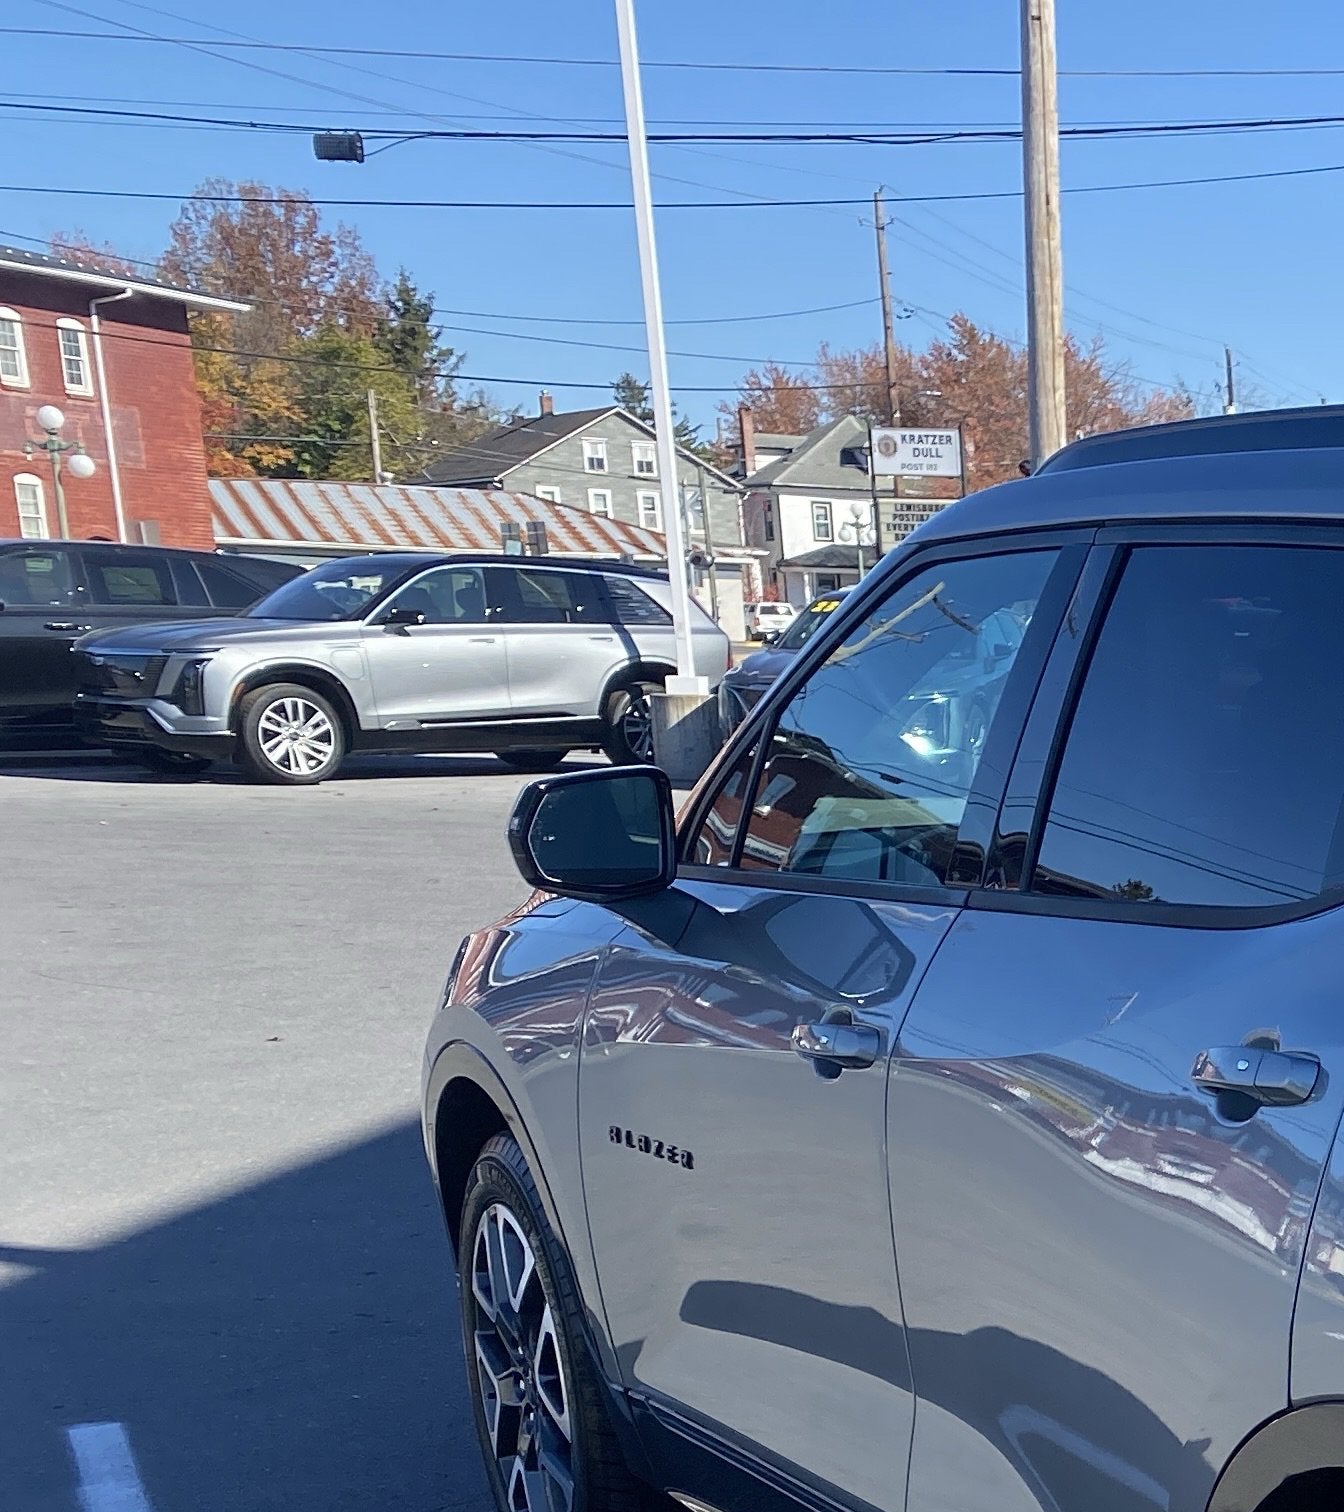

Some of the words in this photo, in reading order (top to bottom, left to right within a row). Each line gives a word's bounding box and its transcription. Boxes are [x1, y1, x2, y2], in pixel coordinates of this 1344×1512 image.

[900, 434, 952, 445] KRATZER
[912, 447, 943, 458] DULL
[901, 463, 924, 471] POST
[608, 1125, 695, 1171] BLAZER
